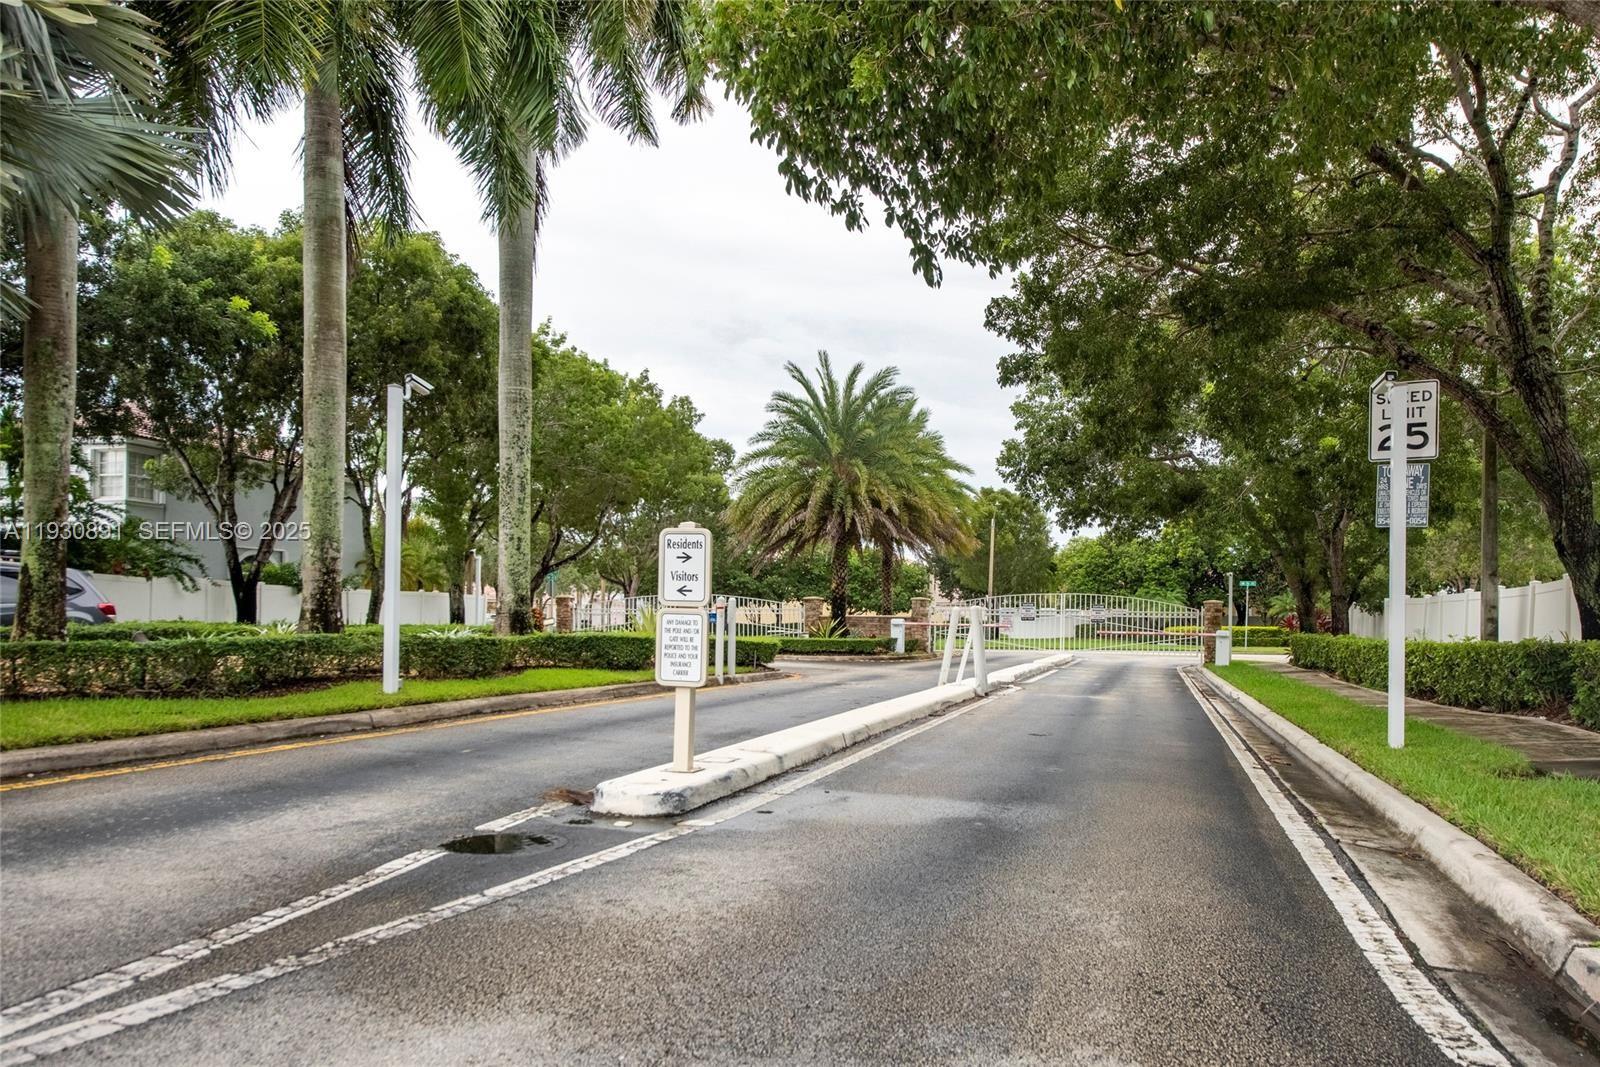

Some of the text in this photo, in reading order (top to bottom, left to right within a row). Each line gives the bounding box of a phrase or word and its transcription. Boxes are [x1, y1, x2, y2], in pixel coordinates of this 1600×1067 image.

[1376, 390, 1432, 405] SED
[1382, 406, 1426, 420] LIT
[666, 538, 703, 550] Residents
[670, 570, 698, 582] Visitors
